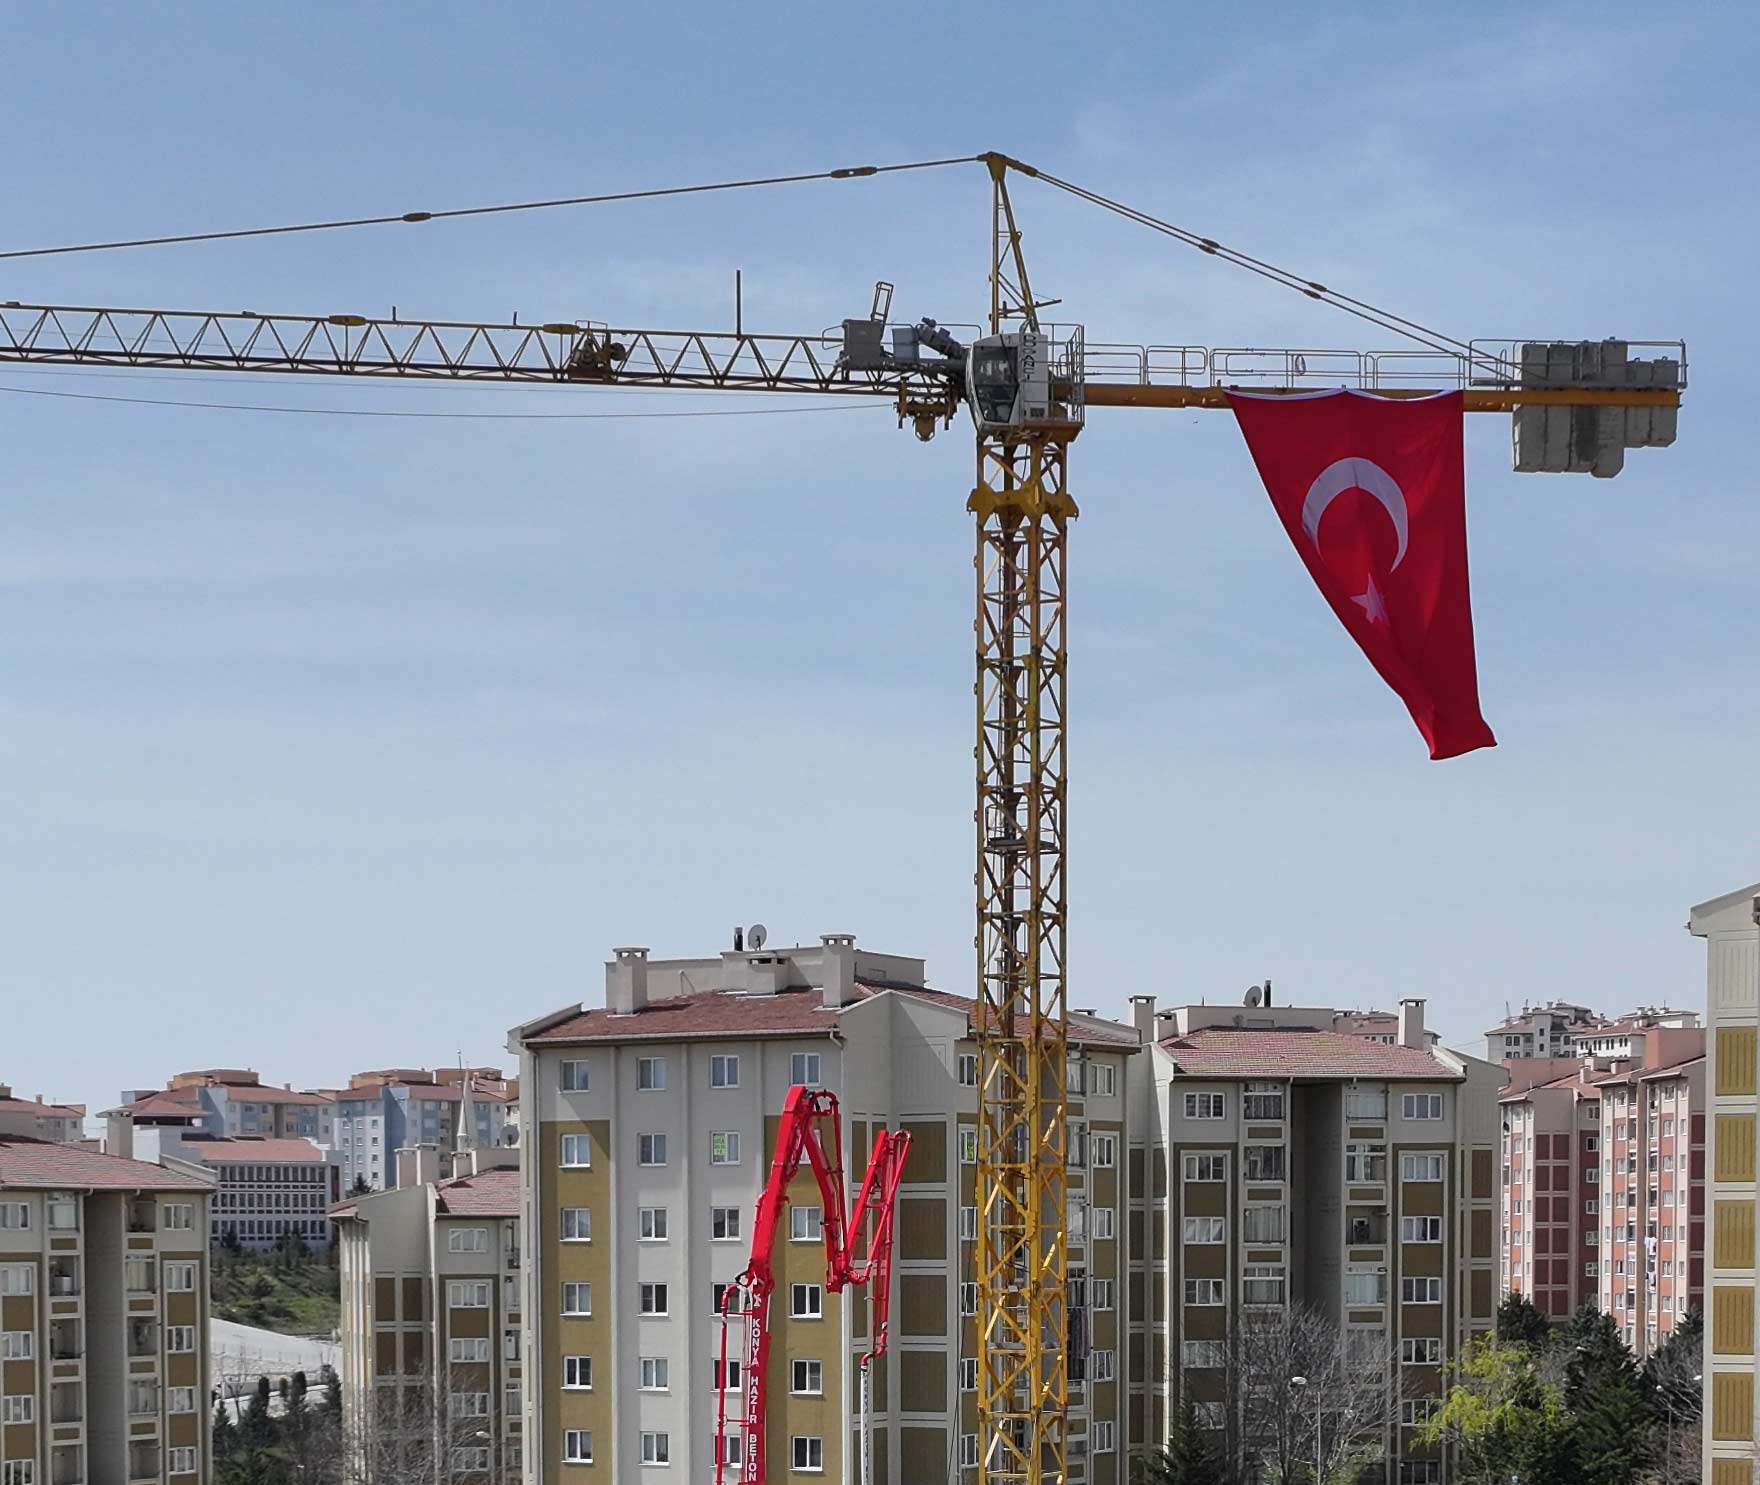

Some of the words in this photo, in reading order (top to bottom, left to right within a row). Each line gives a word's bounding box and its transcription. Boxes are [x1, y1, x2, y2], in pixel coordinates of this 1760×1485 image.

[751, 1318, 761, 1366] KONYA
[749, 1376, 759, 1424] HAZIR
[748, 1434, 757, 1482] BETON
